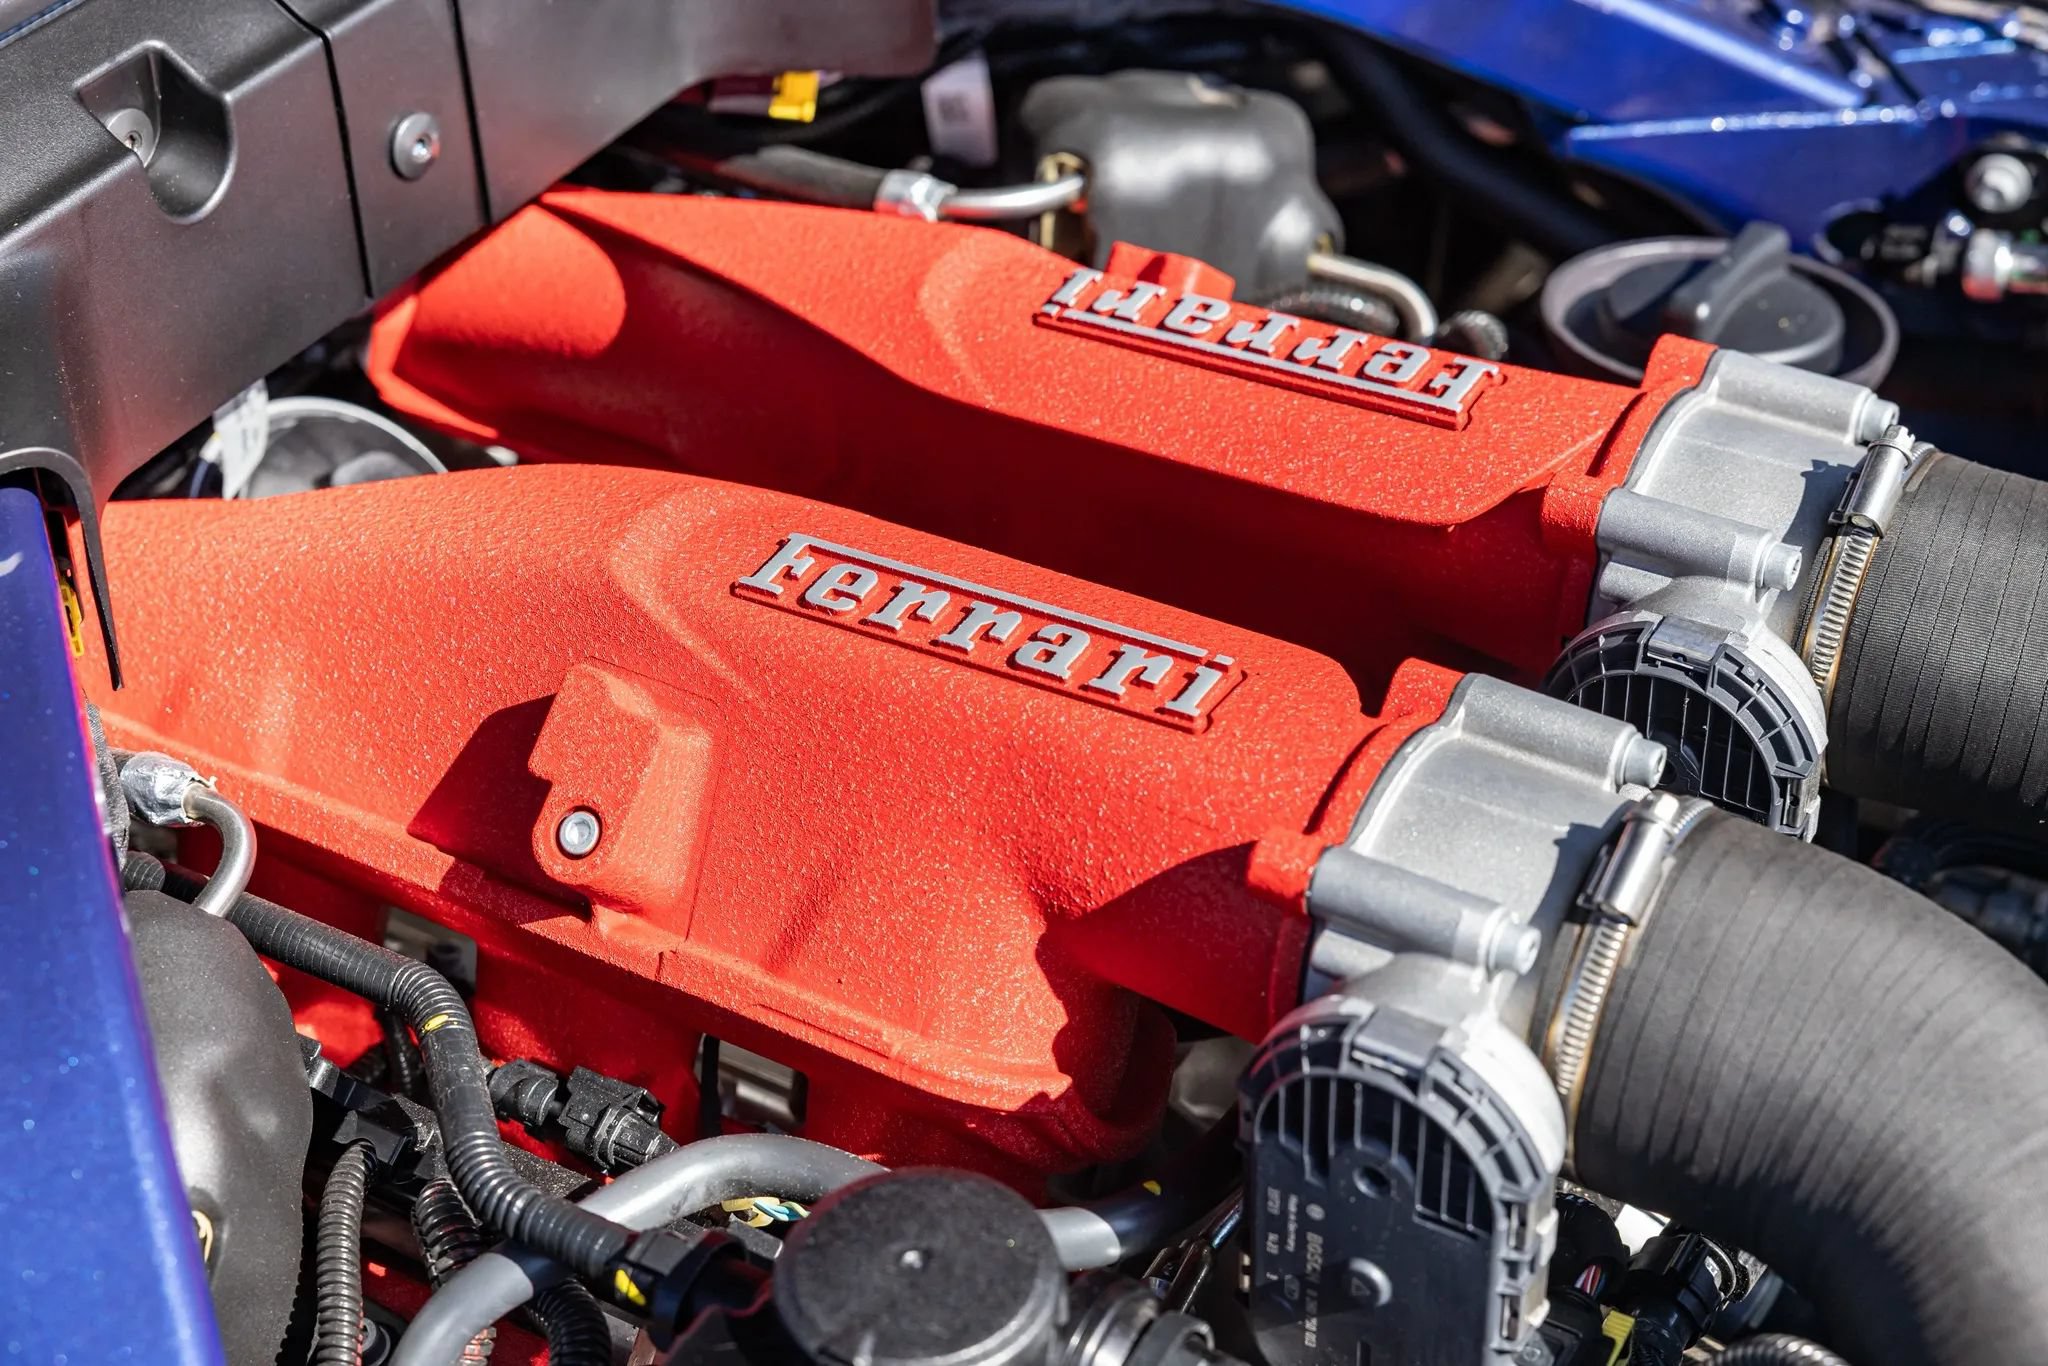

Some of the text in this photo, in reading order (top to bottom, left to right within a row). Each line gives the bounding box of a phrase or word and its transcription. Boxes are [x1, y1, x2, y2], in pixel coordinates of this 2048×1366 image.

[1043, 268, 1500, 413] Ferrari
[738, 532, 1235, 717] Ferrari
[1306, 1231, 1324, 1283] BOSCH
